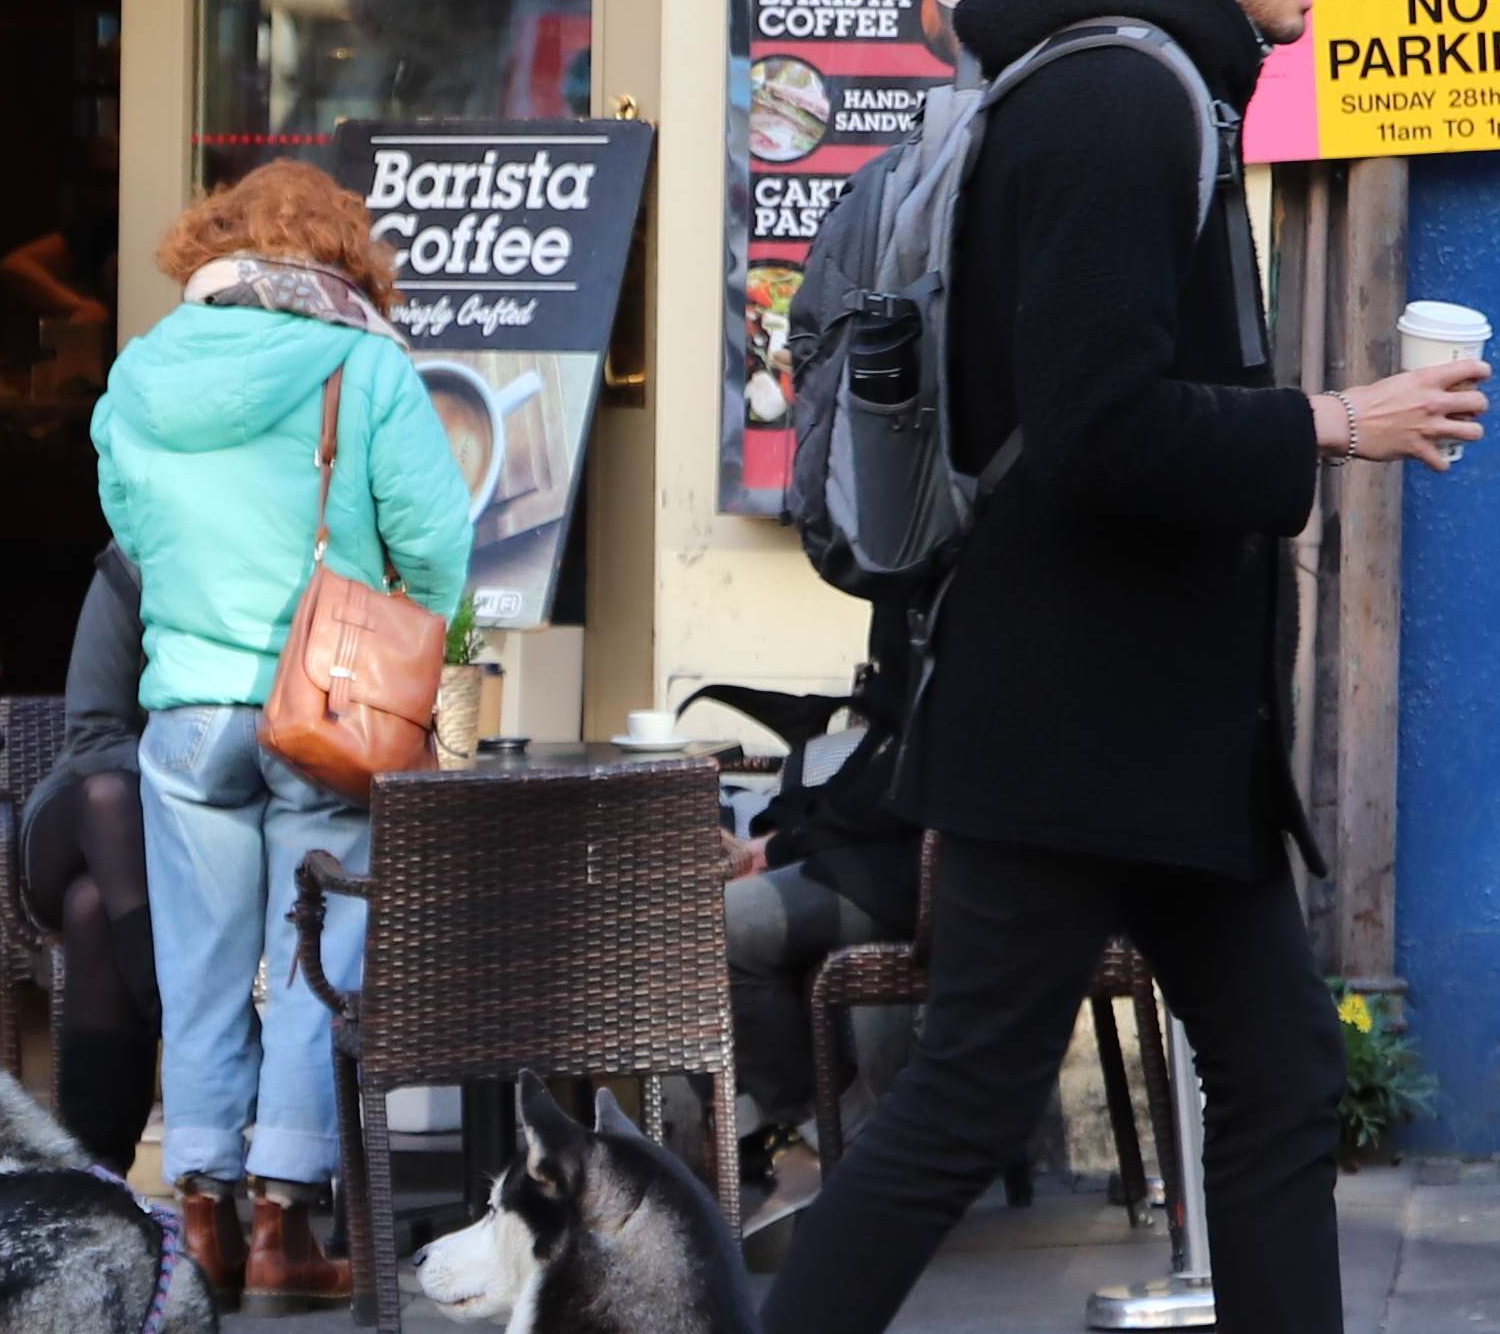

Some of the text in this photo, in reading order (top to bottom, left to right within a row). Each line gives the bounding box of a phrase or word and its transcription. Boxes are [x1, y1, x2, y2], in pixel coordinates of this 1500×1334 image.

[758, 8, 899, 37] COFFEE
[1341, 90, 1437, 114] SUNDAY
[835, 113, 918, 133] SANDW
[1377, 121, 1432, 142] 11am
[1443, 119, 1475, 138] TO
[365, 148, 597, 212] Barista
[755, 210, 826, 236] PAS
[370, 213, 574, 276] Coffee
[391, 294, 538, 336] vingly Crafted
